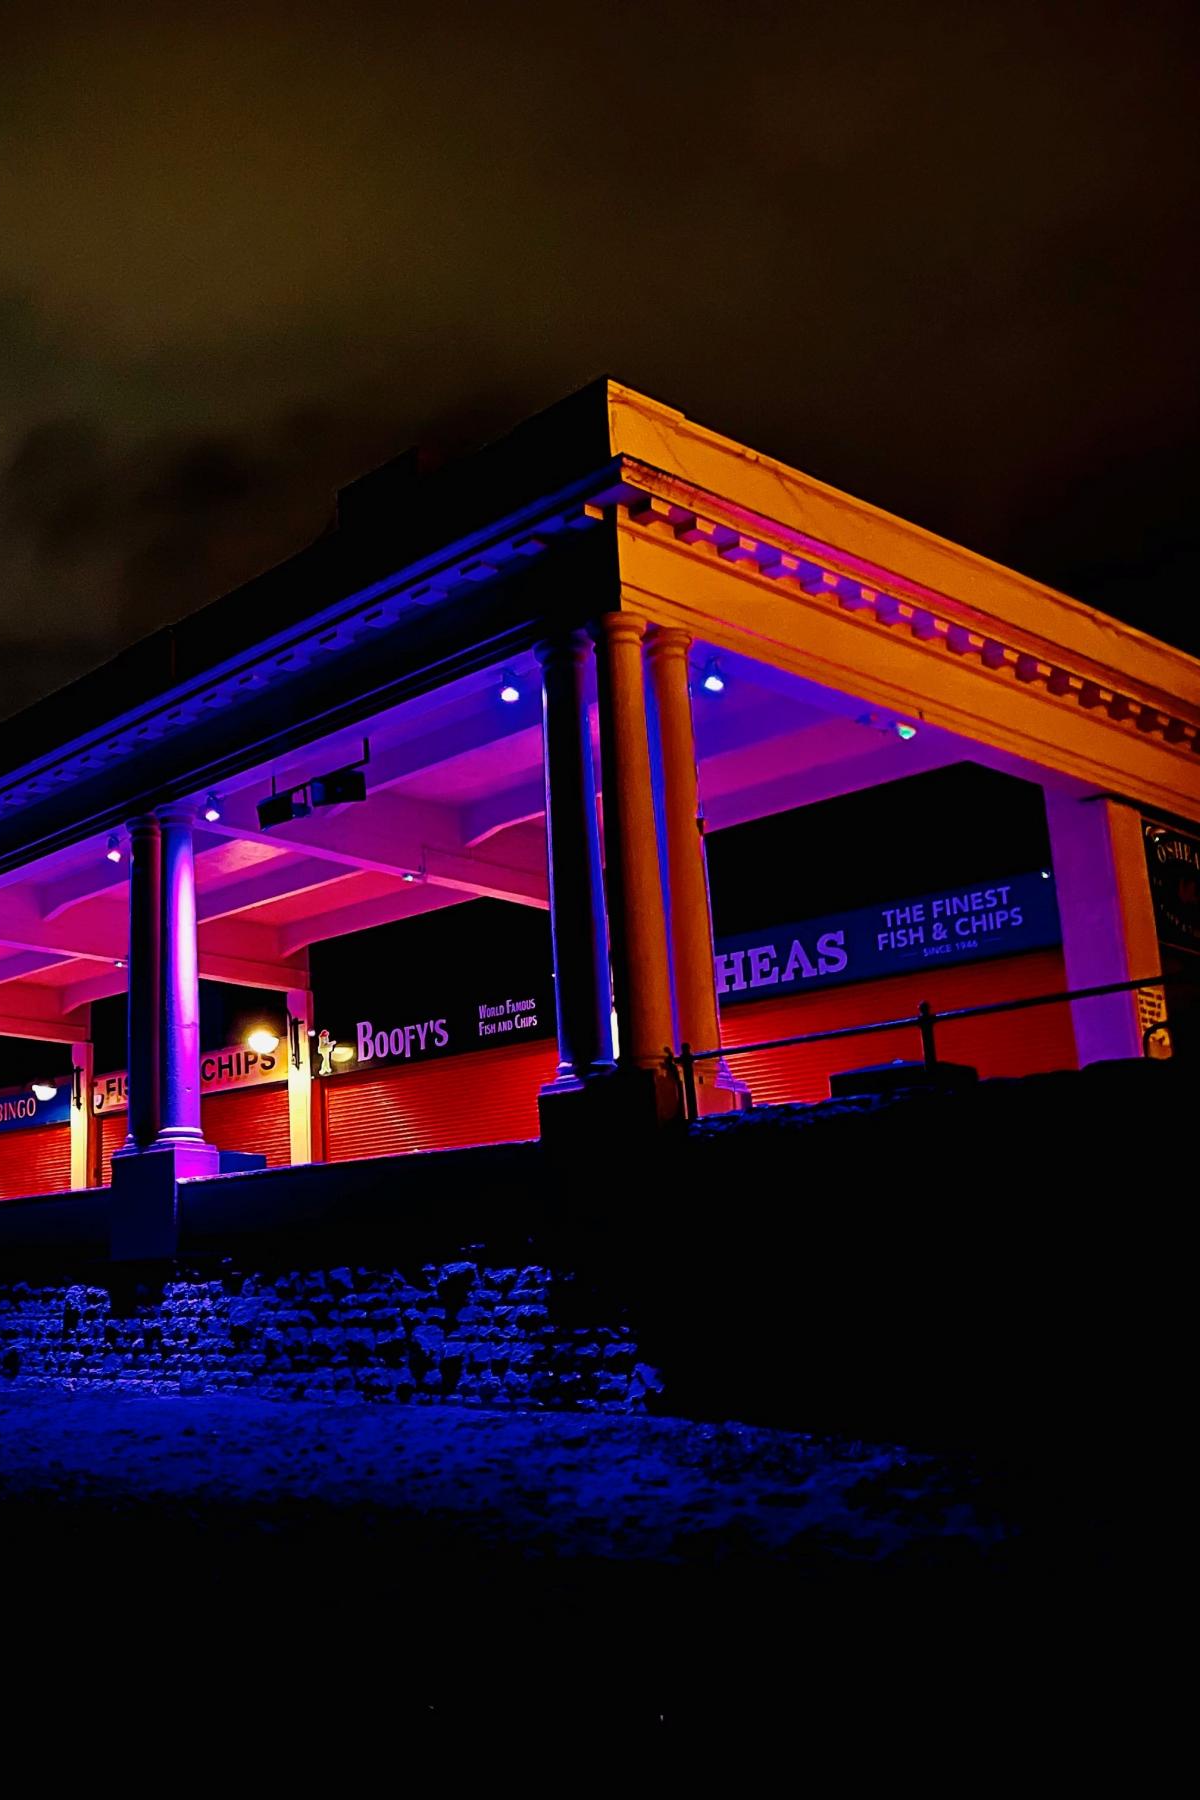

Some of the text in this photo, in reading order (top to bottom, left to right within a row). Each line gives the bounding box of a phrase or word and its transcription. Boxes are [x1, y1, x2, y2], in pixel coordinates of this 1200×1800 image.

[877, 906, 1024, 952] FISH & CHIPS
[882, 886, 1011, 928] THE FINEST
[923, 944, 953, 958] SINCE
[106, 1051, 276, 1098] FI CHIPS
